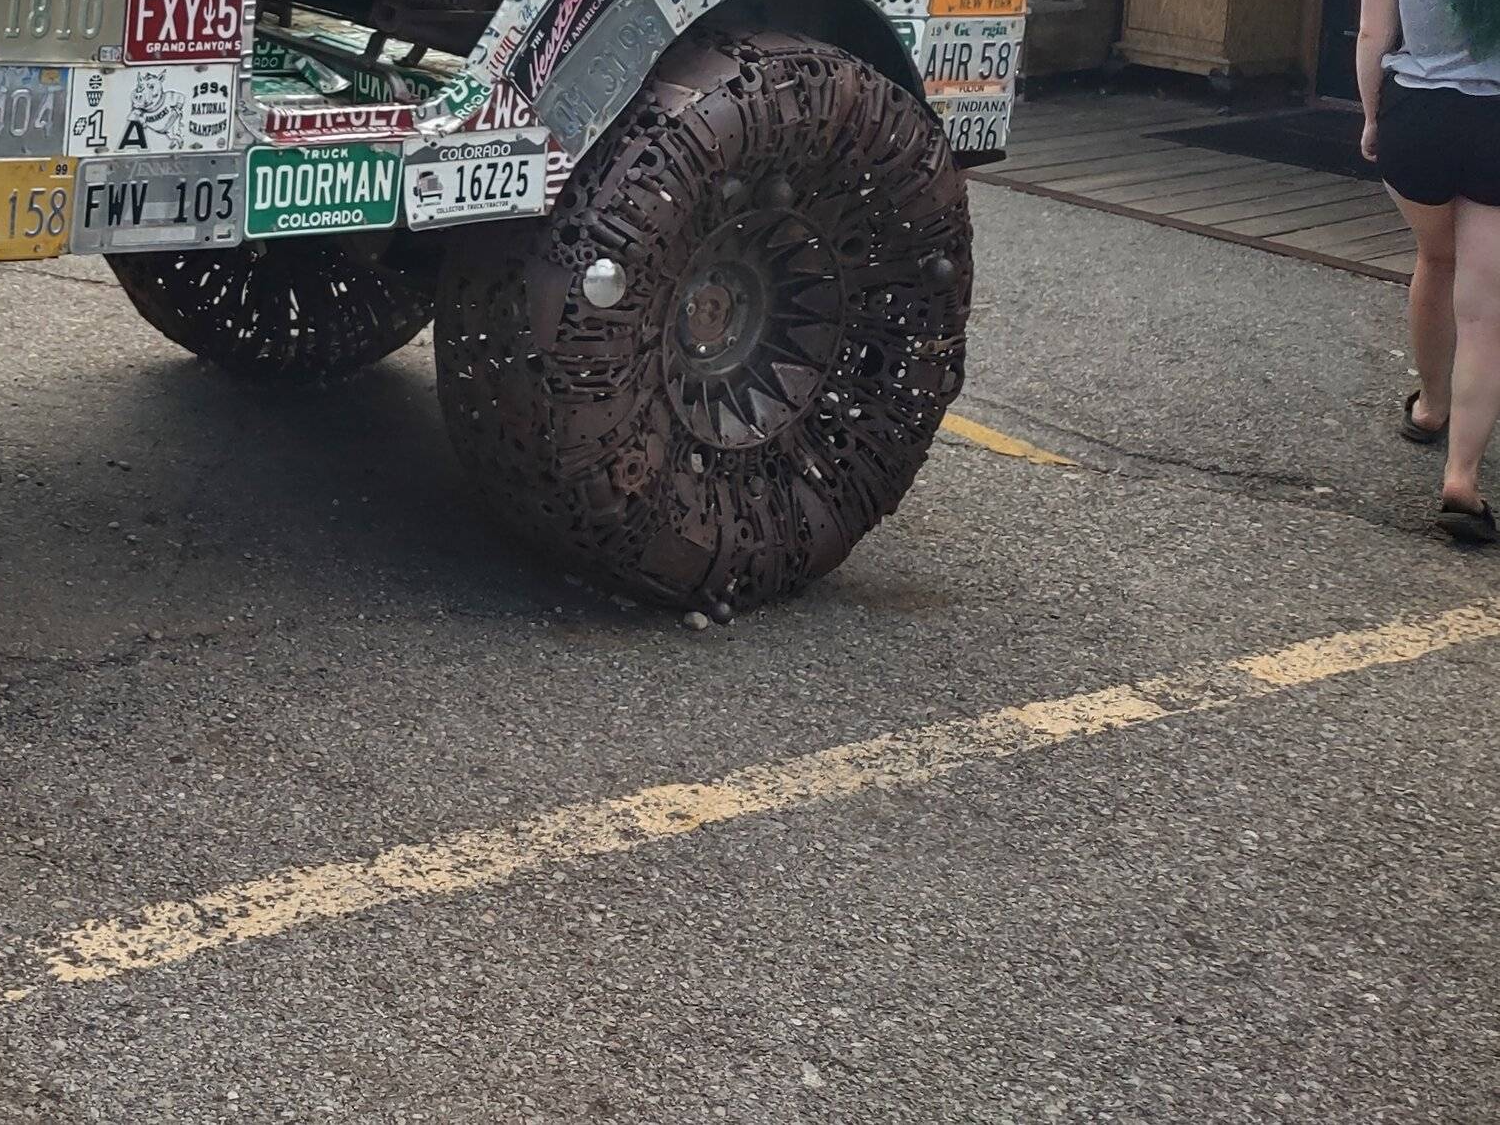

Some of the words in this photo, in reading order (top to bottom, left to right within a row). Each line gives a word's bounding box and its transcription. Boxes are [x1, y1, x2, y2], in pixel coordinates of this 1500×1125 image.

[146, 42, 186, 53] GRAND
[187, 40, 233, 52] CANYON
[530, 28, 546, 51] THE
[560, 40, 574, 55] OF
[923, 42, 973, 82] AHR
[192, 81, 229, 99] 1994
[190, 101, 227, 116] NATIONAL
[956, 100, 1007, 113] INDIANA
[73, 109, 108, 148] #1
[118, 119, 149, 150] A
[188, 118, 228, 137] CHAMPIONS
[303, 147, 349, 161] TRUCK
[439, 143, 512, 162] COLORADO
[55, 163, 68, 176] 99
[254, 159, 395, 211] DOORMAN
[84, 180, 149, 228] FWV
[174, 174, 239, 224] 103
[8, 186, 67, 239] 158
[278, 209, 364, 230] COLORADO
